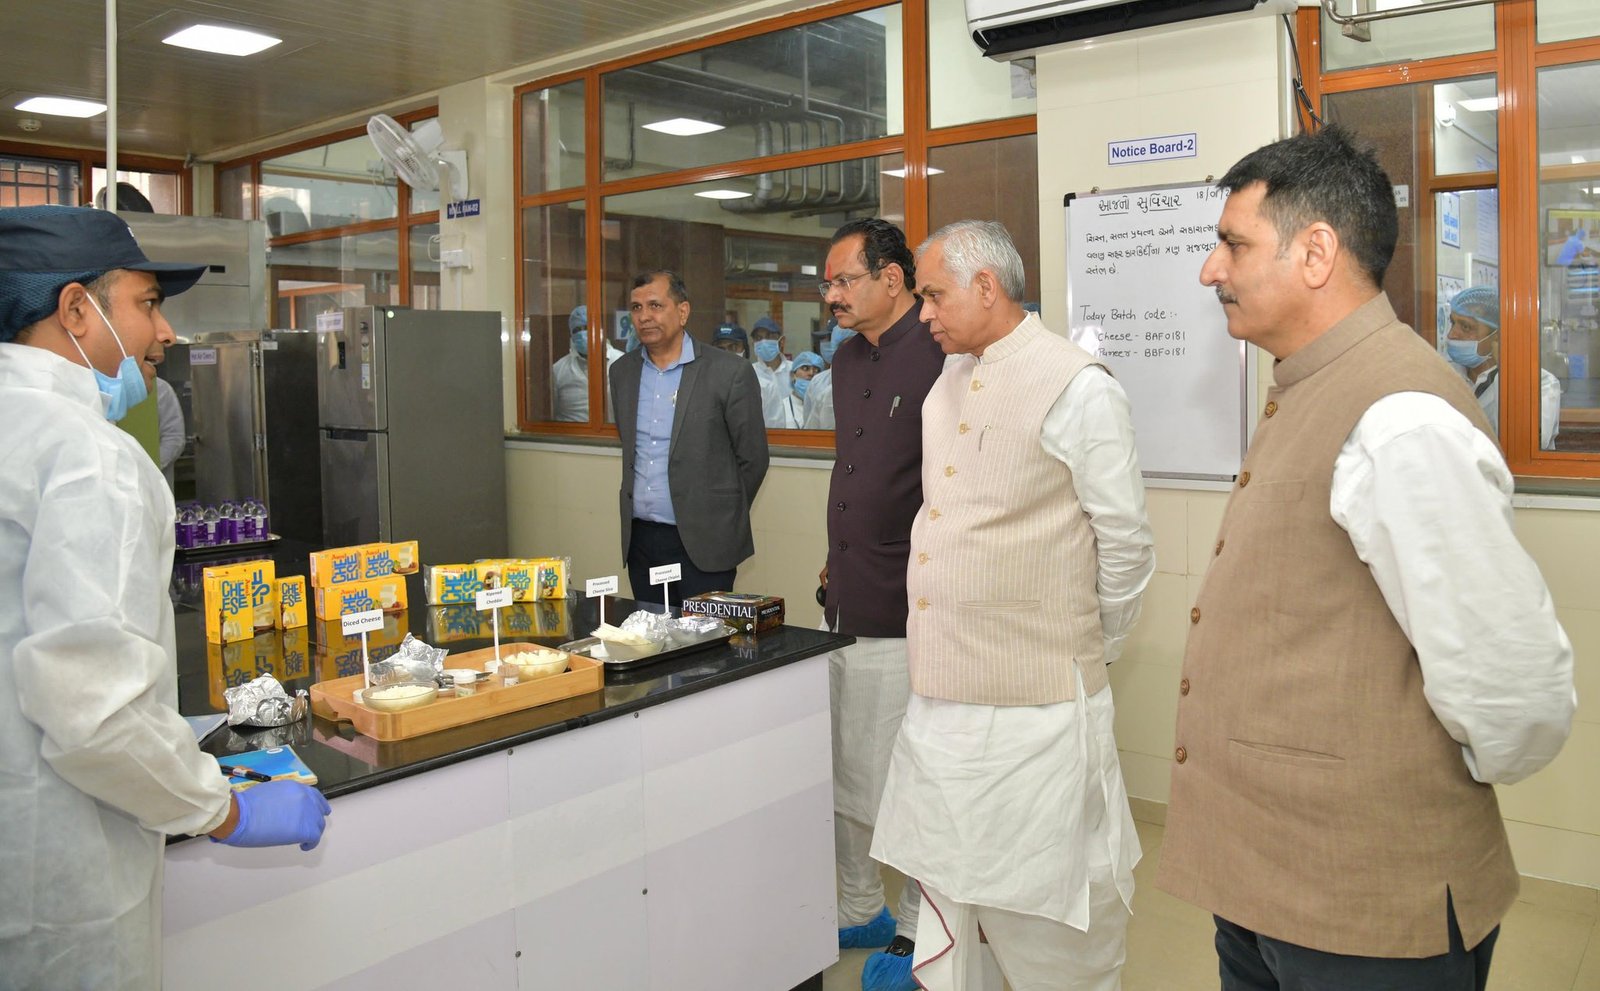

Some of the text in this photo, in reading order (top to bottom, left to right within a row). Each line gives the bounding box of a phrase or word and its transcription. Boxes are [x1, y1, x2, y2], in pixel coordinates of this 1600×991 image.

[1112, 139, 1194, 158] Notice Board-2
[1099, 193, 1182, 213] આજનો સુવિચાર
[1080, 305, 1106, 325] Today
[1111, 308, 1136, 320] Batch
[683, 600, 754, 619] PRESIDENTIAL
[343, 616, 381, 627] Diced Cheese
